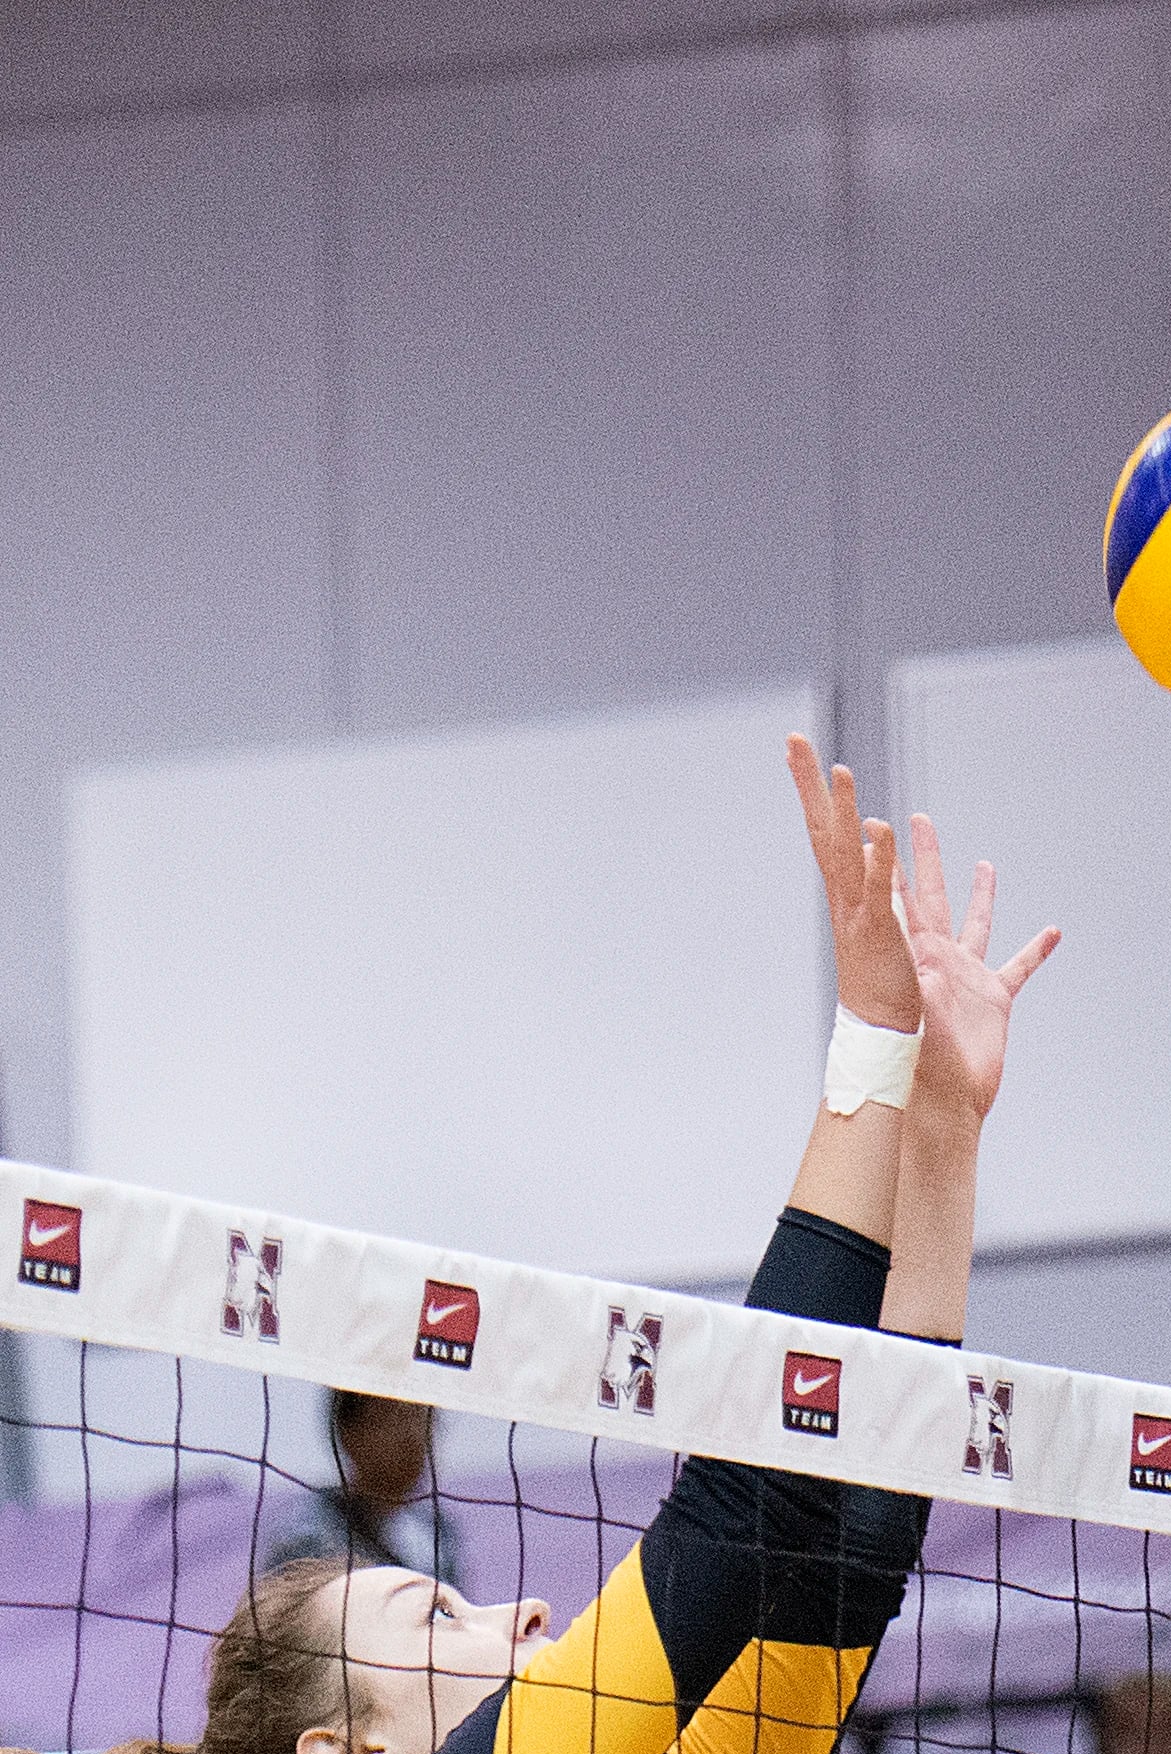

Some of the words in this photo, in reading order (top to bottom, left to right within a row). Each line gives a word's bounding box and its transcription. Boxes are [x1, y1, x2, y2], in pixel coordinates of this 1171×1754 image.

[23, 1260, 72, 1285] TEAM
[419, 1338, 467, 1362] TEAM
[789, 1407, 831, 1430] TEAM
